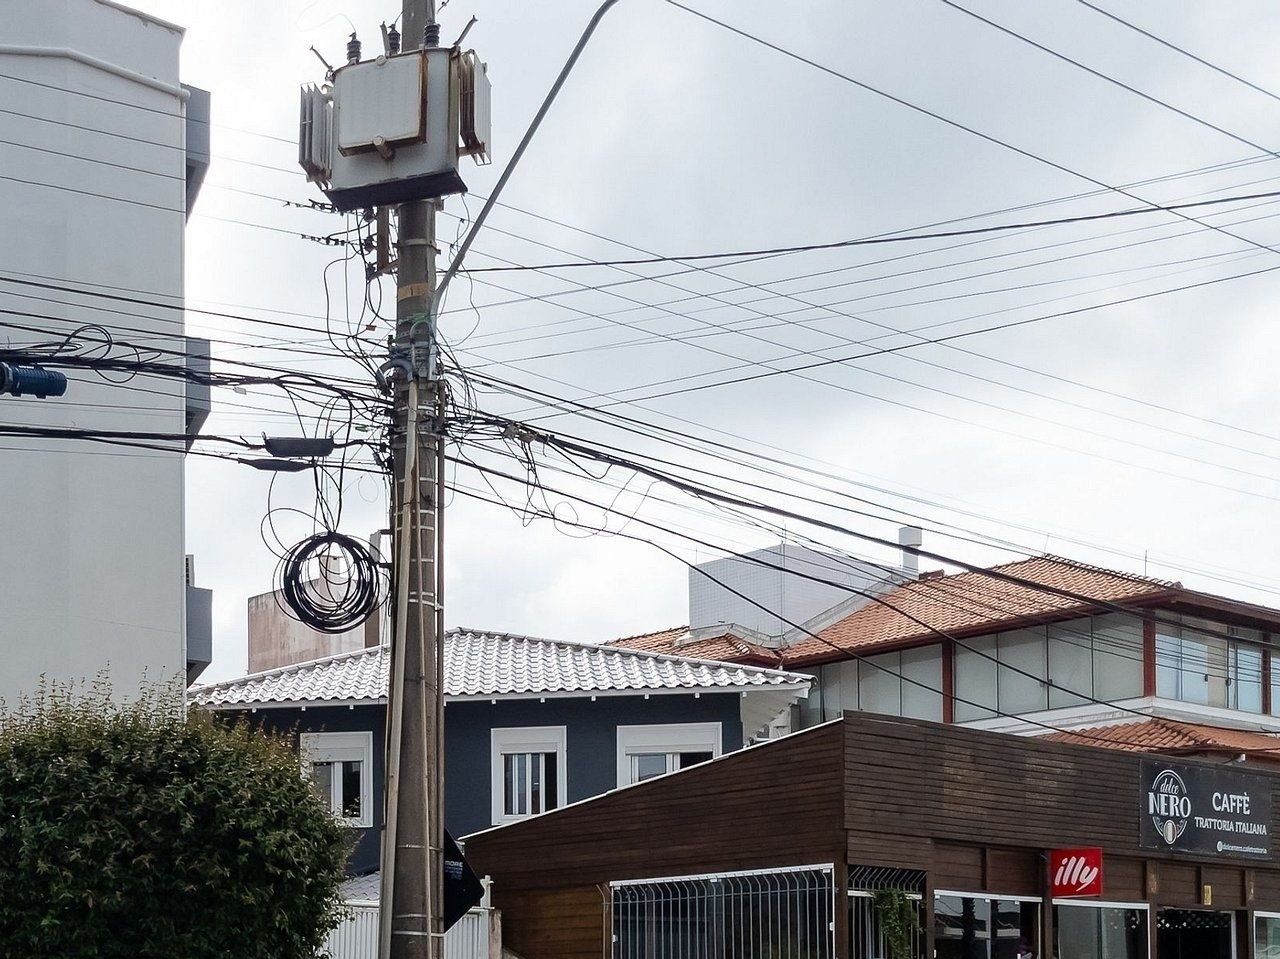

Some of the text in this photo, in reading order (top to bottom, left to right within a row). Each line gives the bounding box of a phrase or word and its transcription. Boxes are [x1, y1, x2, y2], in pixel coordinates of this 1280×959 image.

[1148, 792, 1191, 818] NERO
[1212, 791, 1250, 815] CAFFÈ
[1194, 817, 1267, 836] TRATTORIA ITALIANA
[1054, 856, 1098, 892] illy
